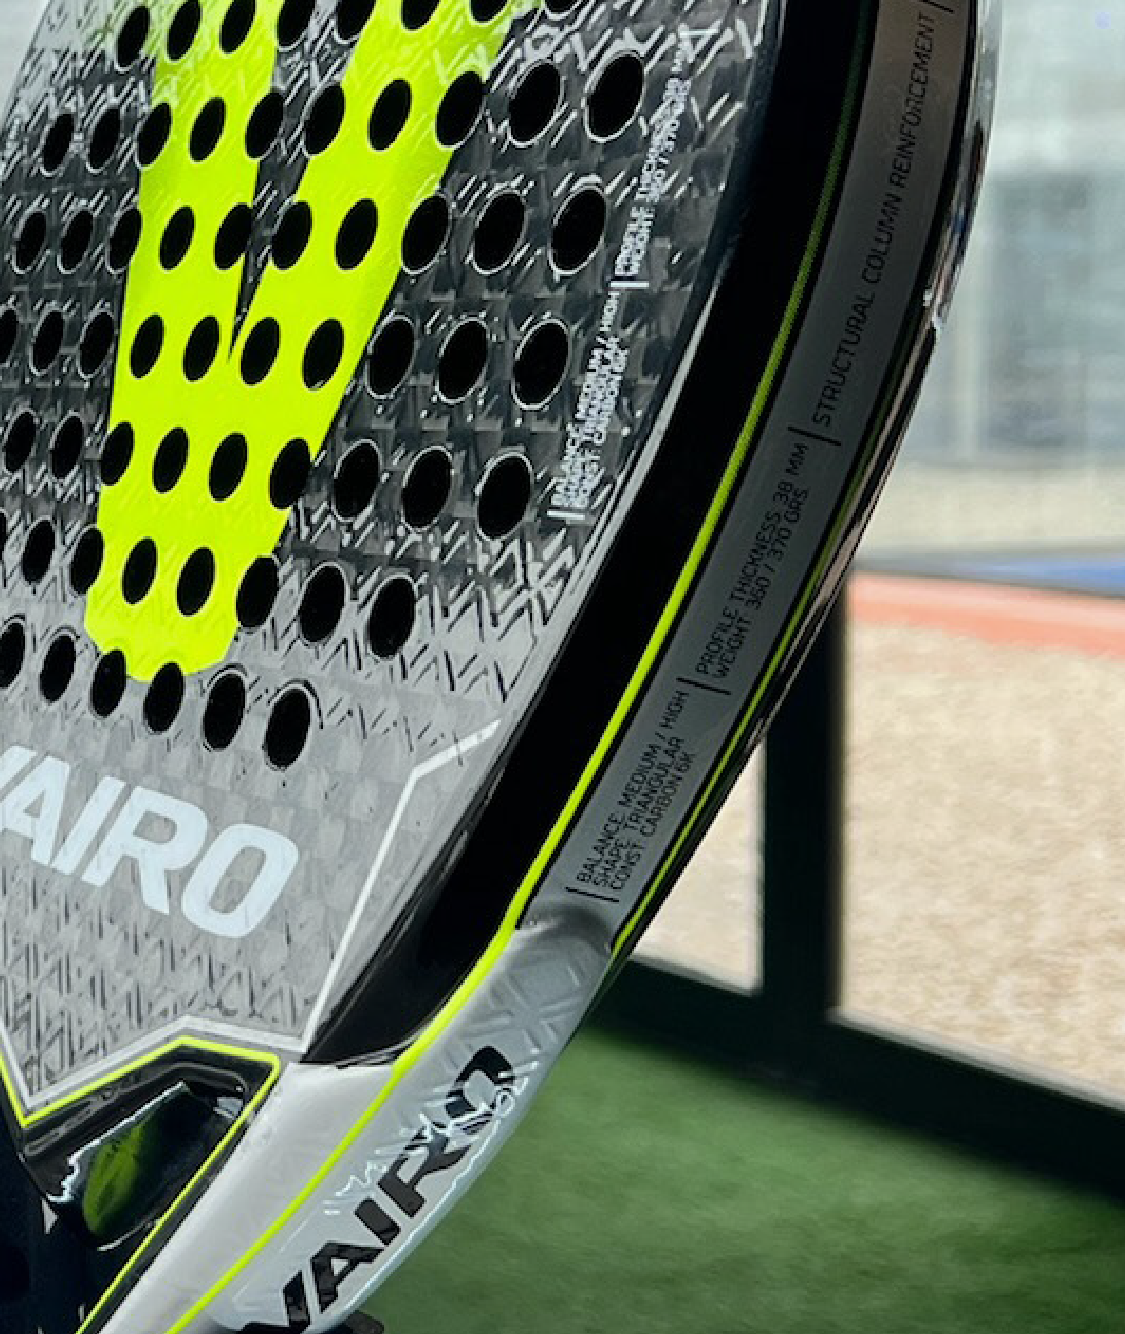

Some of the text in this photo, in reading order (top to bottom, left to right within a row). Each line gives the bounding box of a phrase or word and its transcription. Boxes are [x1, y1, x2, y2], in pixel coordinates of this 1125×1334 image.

[813, 12, 935, 427] STRUCTURAL COLUMN REINFORCEMENT
[695, 607, 738, 674] PROFILE
[773, 481, 793, 505] 38
[786, 443, 809, 475] MM
[767, 527, 792, 561] 370
[618, 743, 661, 807] MEDIUM
[659, 691, 689, 729] HIGH
